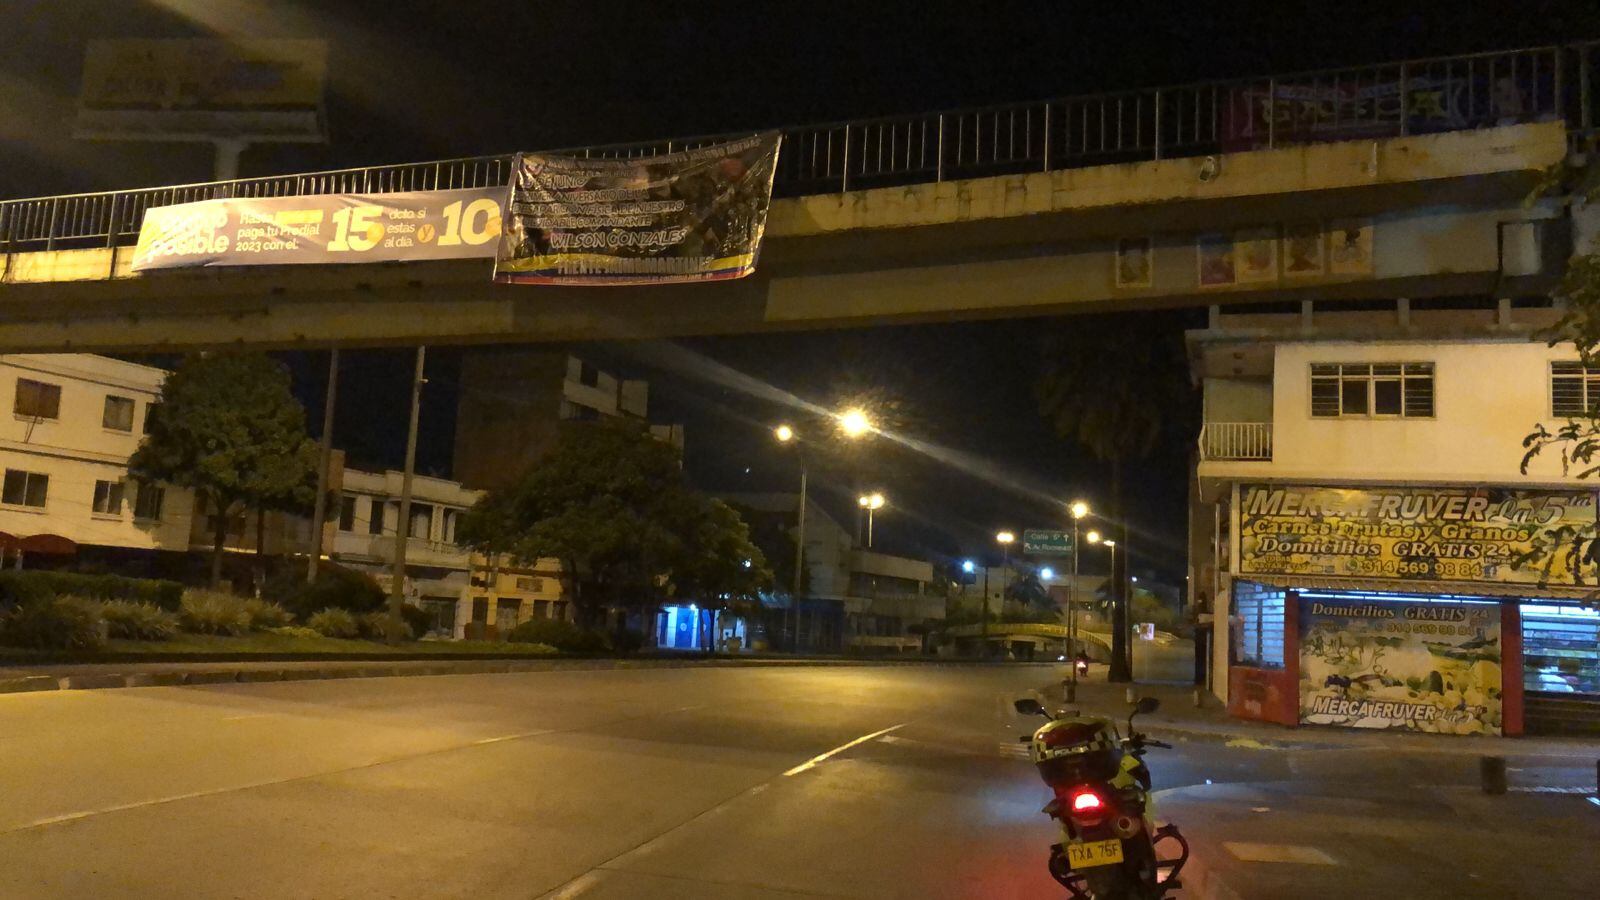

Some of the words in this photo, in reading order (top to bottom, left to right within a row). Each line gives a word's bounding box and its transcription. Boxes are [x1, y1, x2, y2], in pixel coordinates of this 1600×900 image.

[554, 190, 616, 202] ANIVERSARIO
[327, 205, 384, 252] 15
[438, 198, 501, 247] 10
[576, 215, 653, 229] COMANDANTE
[237, 226, 266, 241] paga
[267, 226, 279, 237] tu
[280, 223, 321, 237] Predial
[421, 225, 433, 241] y
[550, 231, 607, 249] WILSON
[608, 228, 688, 247] GONZALES
[236, 240, 262, 253] 2023
[263, 241, 285, 251] con
[384, 236, 395, 248] al
[1488, 499, 1530, 524] La
[1253, 518, 1331, 537] Carnes
[1441, 525, 1530, 542] Granos
[1262, 538, 1382, 556] Domicilios
[1392, 541, 1482, 559] GRATIS
[1486, 543, 1511, 556] 24
[1366, 560, 1396, 574] 314
[1399, 561, 1430, 575] 569
[1435, 562, 1457, 577] 98
[1460, 563, 1483, 578] 84
[1312, 603, 1395, 619] Domicilios
[1404, 606, 1466, 622] GRATIS
[1472, 609, 1489, 620] 24
[1312, 694, 1371, 716] MERCA
[1372, 700, 1437, 721] FRUVER
[1070, 846, 1094, 862] TXA
[1097, 842, 1120, 859] 75F
